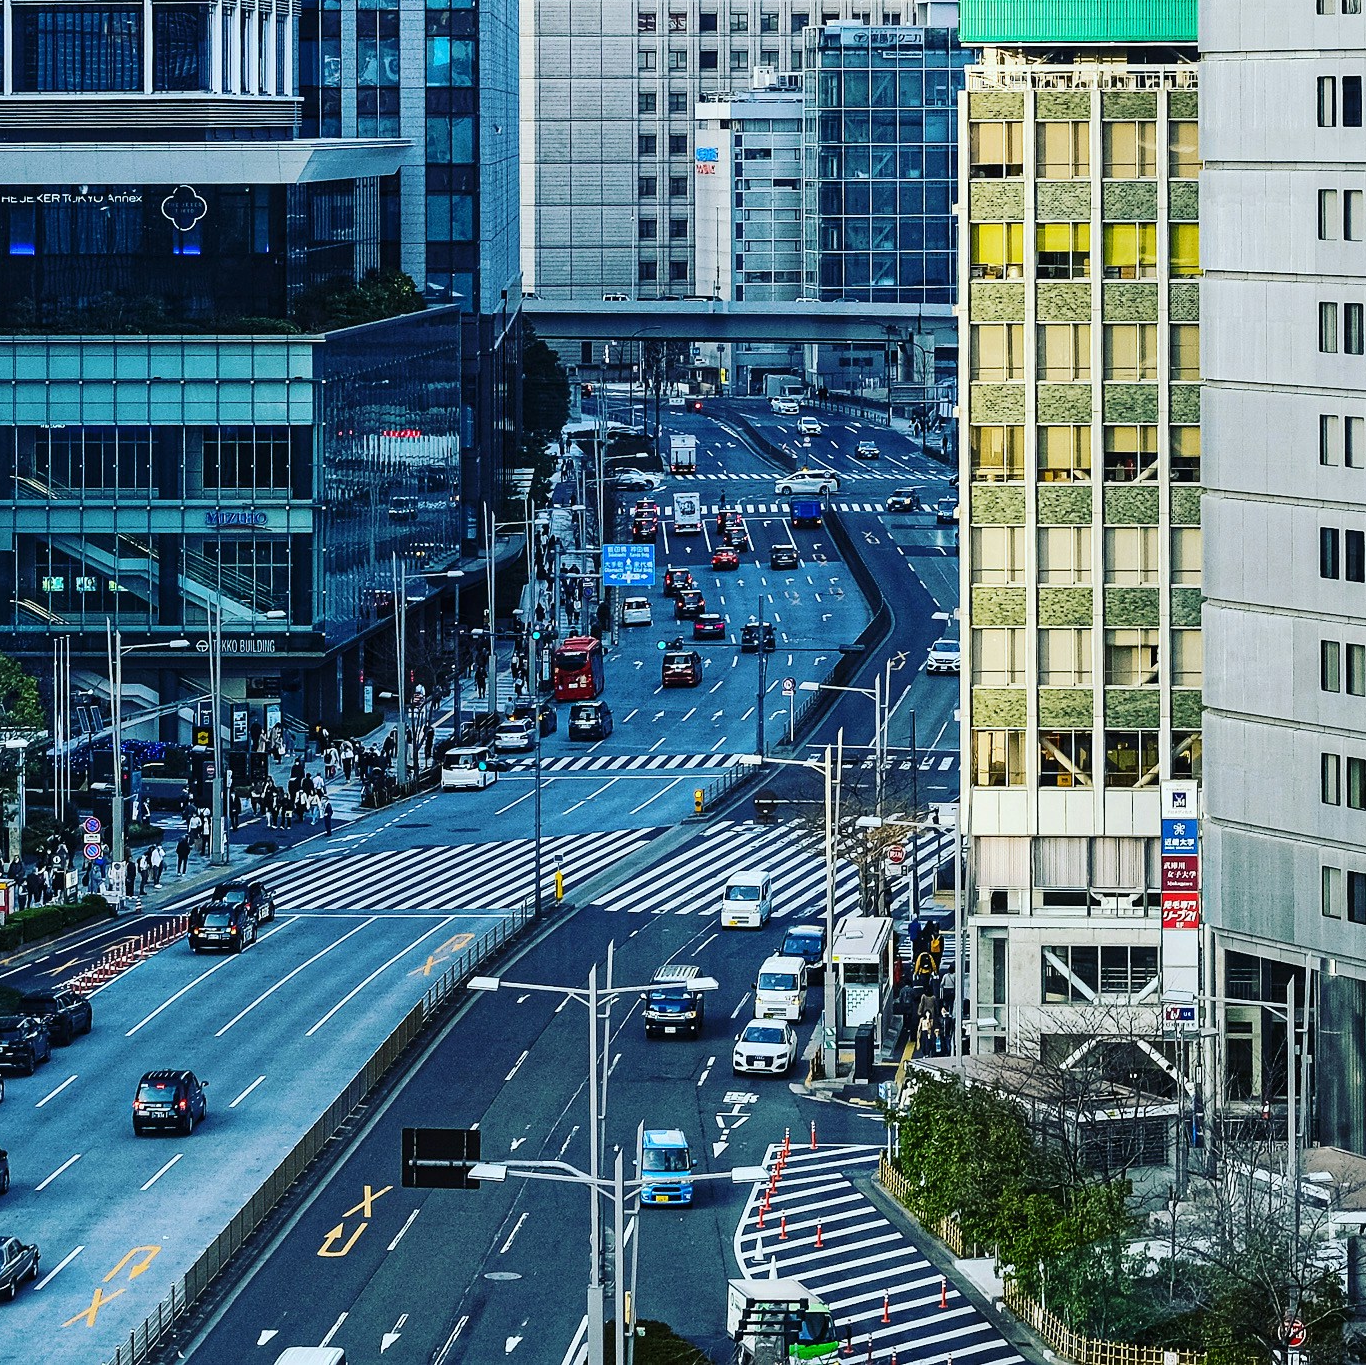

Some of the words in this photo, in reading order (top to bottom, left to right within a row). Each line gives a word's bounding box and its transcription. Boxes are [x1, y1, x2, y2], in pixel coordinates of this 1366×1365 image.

[205, 511, 268, 525] MIZUHO
[212, 639, 238, 653] TKKO
[239, 639, 276, 653] BUILDING
[1167, 870, 1196, 879] 女子大学
[1163, 910, 1197, 922] リーブ21
